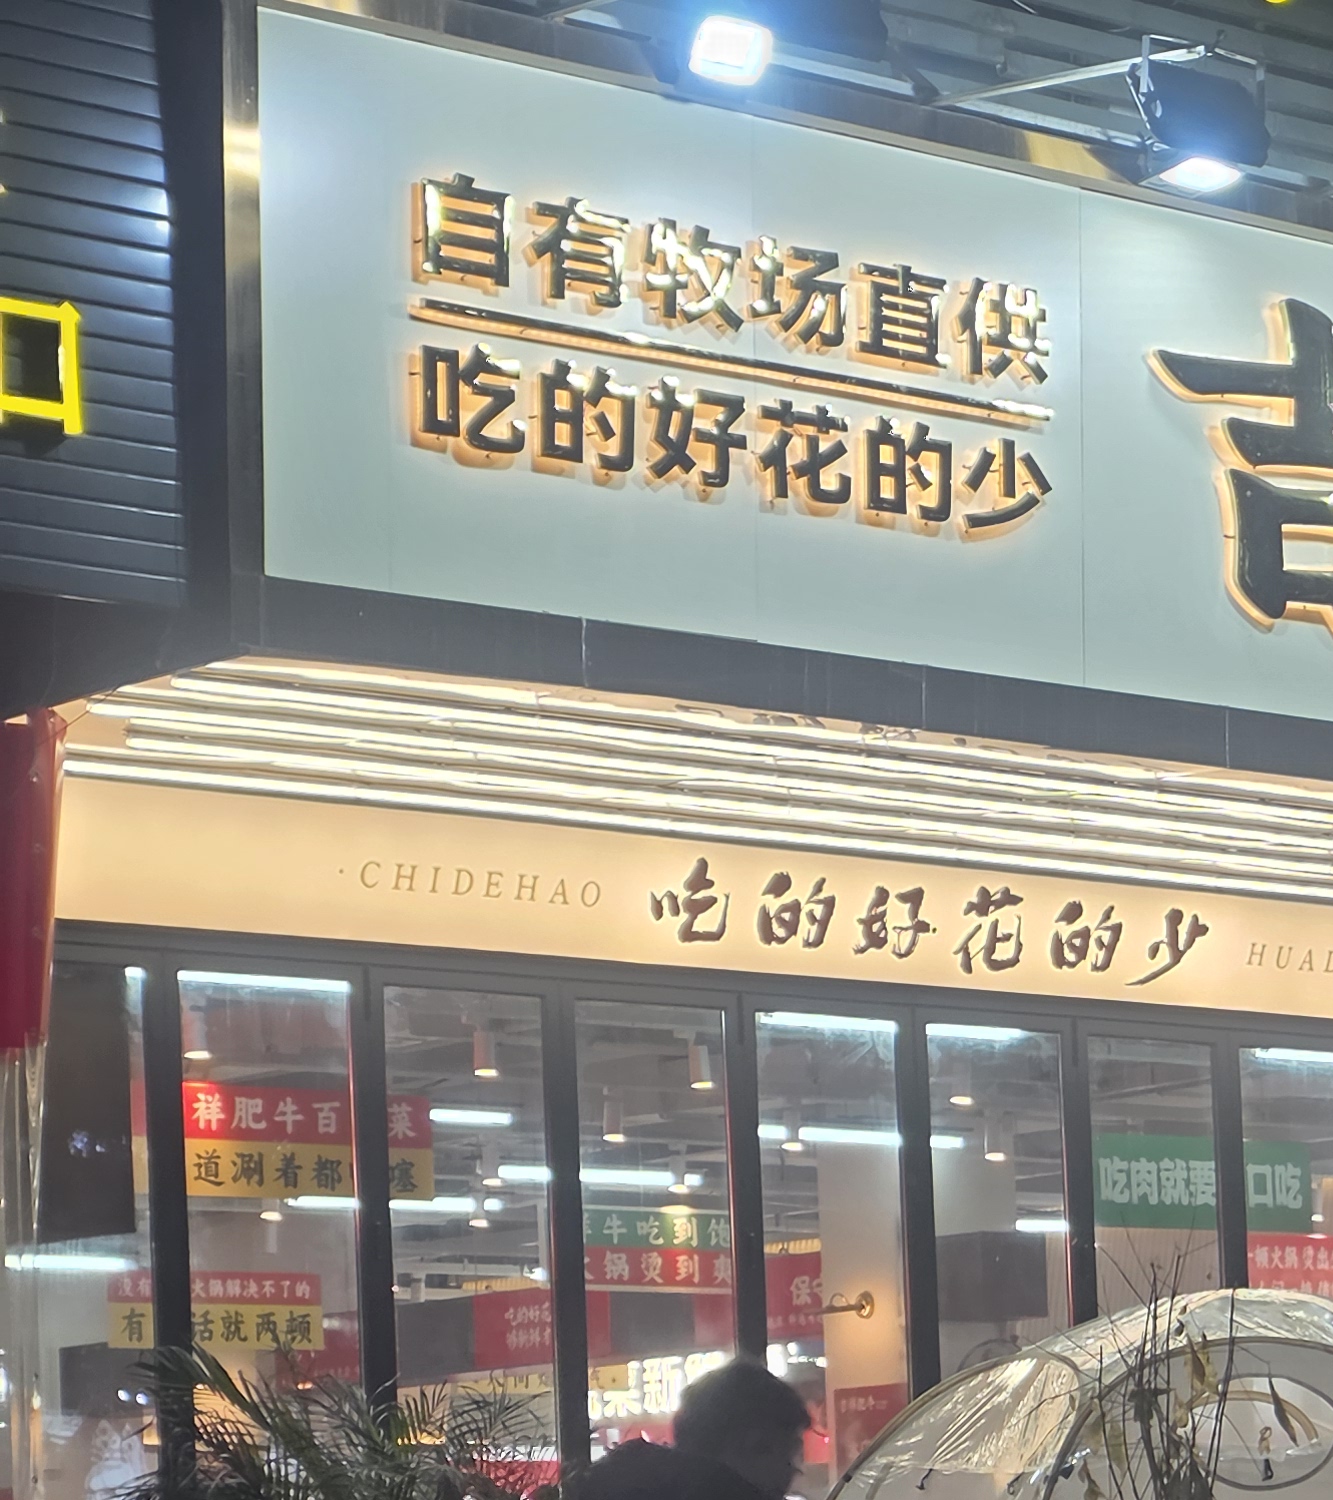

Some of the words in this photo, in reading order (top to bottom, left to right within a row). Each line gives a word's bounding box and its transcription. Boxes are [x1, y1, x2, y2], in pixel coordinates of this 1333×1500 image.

[412, 173, 1051, 386] 自有牧场直供
[412, 342, 1053, 537] 吃的好花的少
[359, 862, 602, 908] CHIDEHAO
[650, 857, 1210, 987] 吃的好花的少
[1098, 1156, 1303, 1209] 吃肉就要口吃
